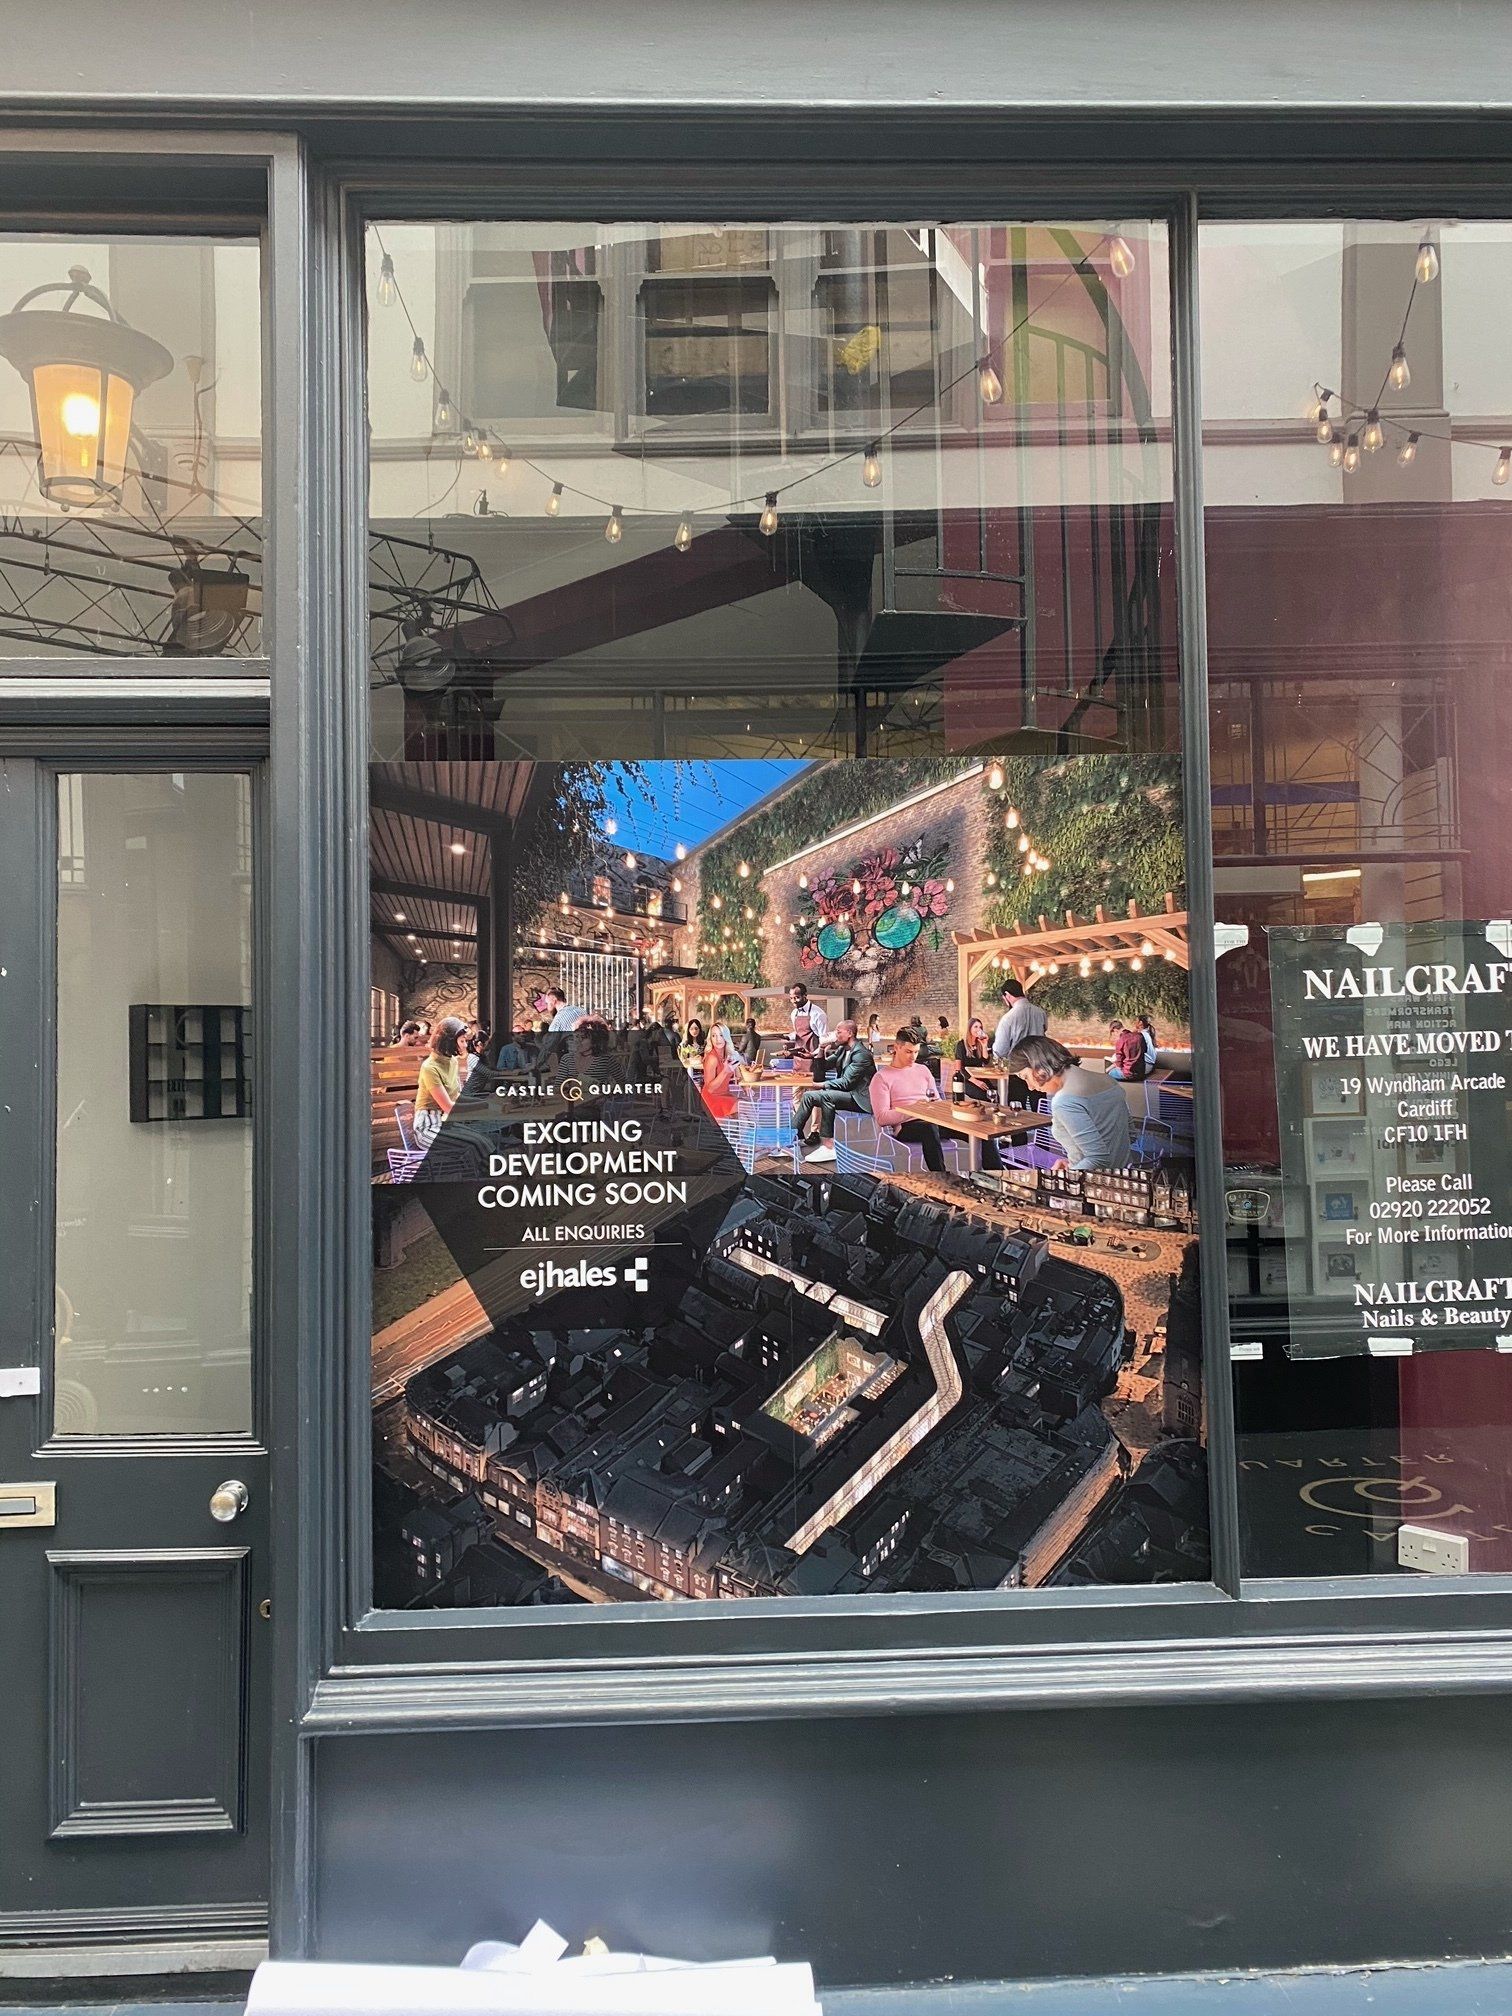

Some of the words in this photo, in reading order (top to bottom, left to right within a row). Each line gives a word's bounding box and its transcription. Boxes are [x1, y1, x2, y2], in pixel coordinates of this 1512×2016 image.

[1302, 962, 1512, 1000] NAILCRAF
[1301, 1036, 1340, 1059] WE
[1344, 1033, 1411, 1058] HAVE
[1415, 1030, 1501, 1055] MOVED
[495, 1084, 554, 1097] CASTLE
[588, 1083, 663, 1095] QUARTER
[1340, 1077, 1362, 1095] 19
[1366, 1075, 1445, 1097] Wyndham
[1450, 1072, 1506, 1091] Arcade
[1397, 1098, 1453, 1118] Cardiff
[523, 1119, 642, 1145] EXCITING
[1384, 1124, 1428, 1144] CF10
[1433, 1123, 1467, 1141] 1FH
[489, 1150, 677, 1177] DEVELOPMENT
[477, 1183, 596, 1209] COMING
[605, 1180, 687, 1205] SOON
[1386, 1176, 1437, 1194] Please
[1441, 1173, 1473, 1191] Call
[1369, 1200, 1423, 1219] 02920
[1427, 1197, 1492, 1217] 222052
[521, 1226, 550, 1242] ALL
[555, 1223, 645, 1241] ENQUIRIES
[1346, 1227, 1373, 1246] For
[1377, 1225, 1420, 1244] More
[519, 1259, 617, 1296] ejhales
[1362, 1308, 1414, 1328] Nails
[1420, 1308, 1439, 1326] &
[1443, 1306, 1512, 1329] Beauty
